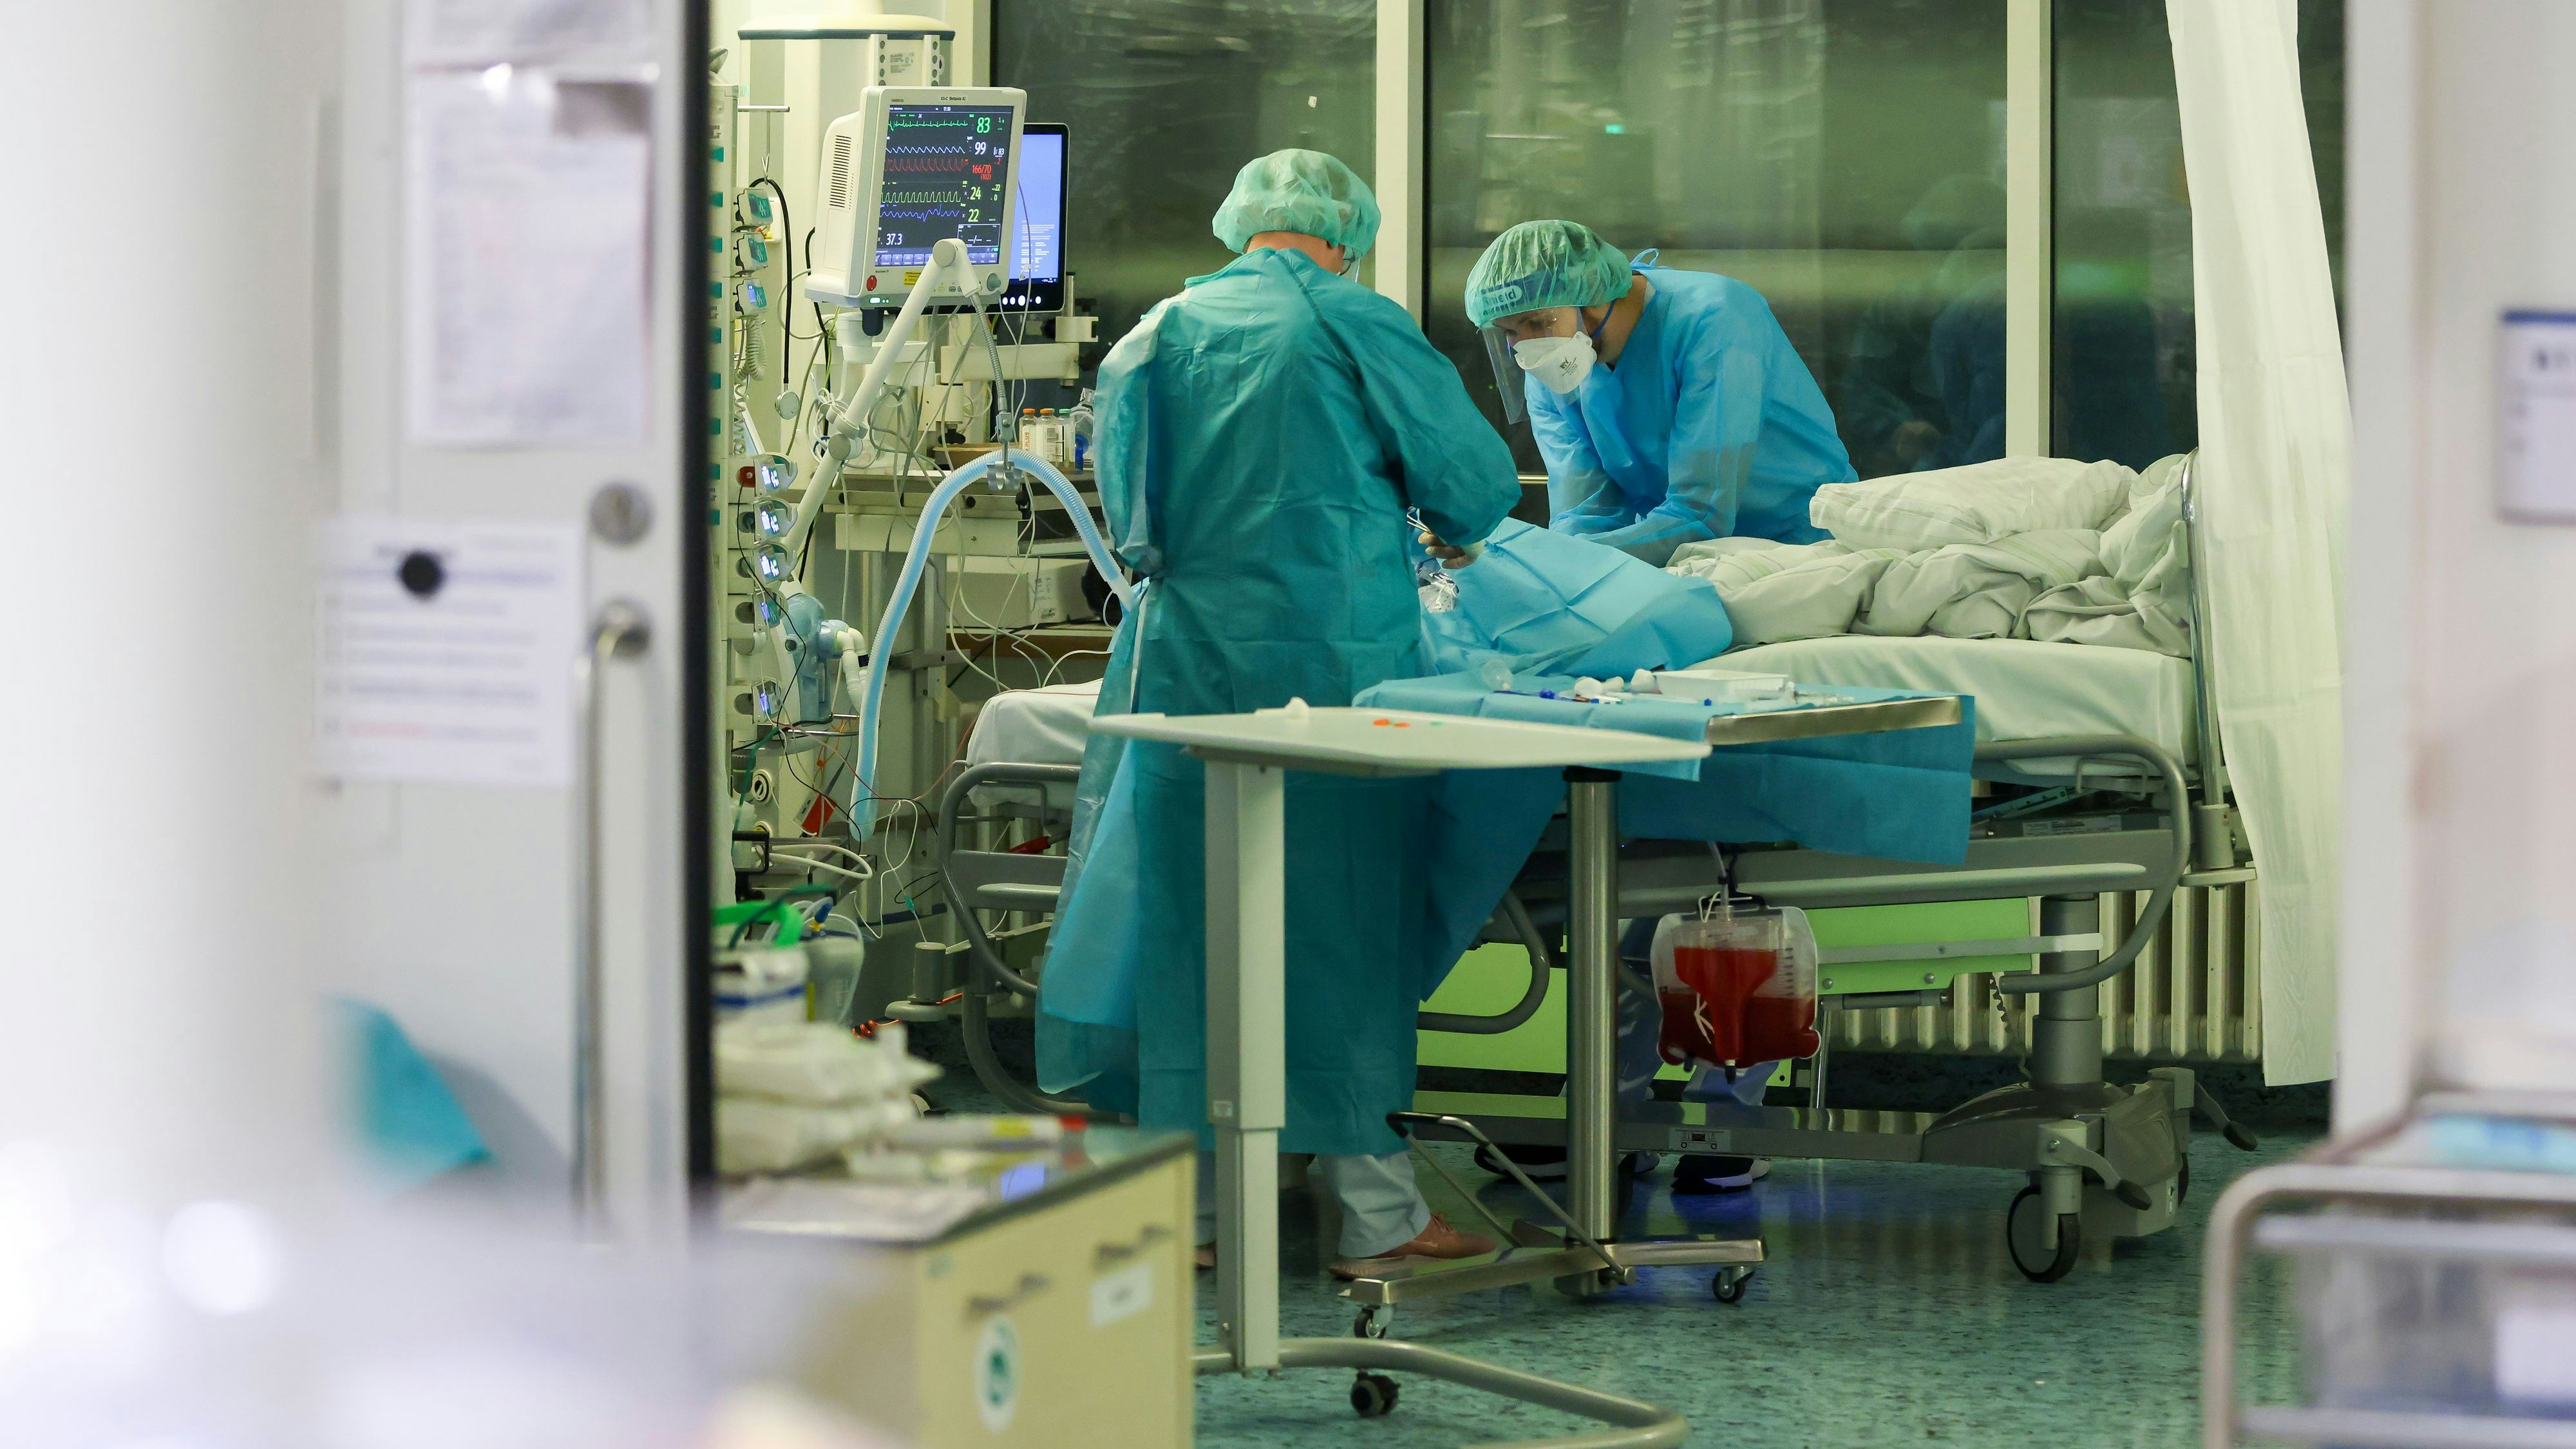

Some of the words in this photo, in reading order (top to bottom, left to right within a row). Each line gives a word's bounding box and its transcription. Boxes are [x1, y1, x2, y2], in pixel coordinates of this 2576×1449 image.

[976, 117, 990, 133] 83
[974, 142, 987, 155] 99
[972, 164, 992, 174] 166/70
[970, 186, 981, 200] 24
[968, 209, 979, 222] 22
[886, 233, 902, 245] 37.3
